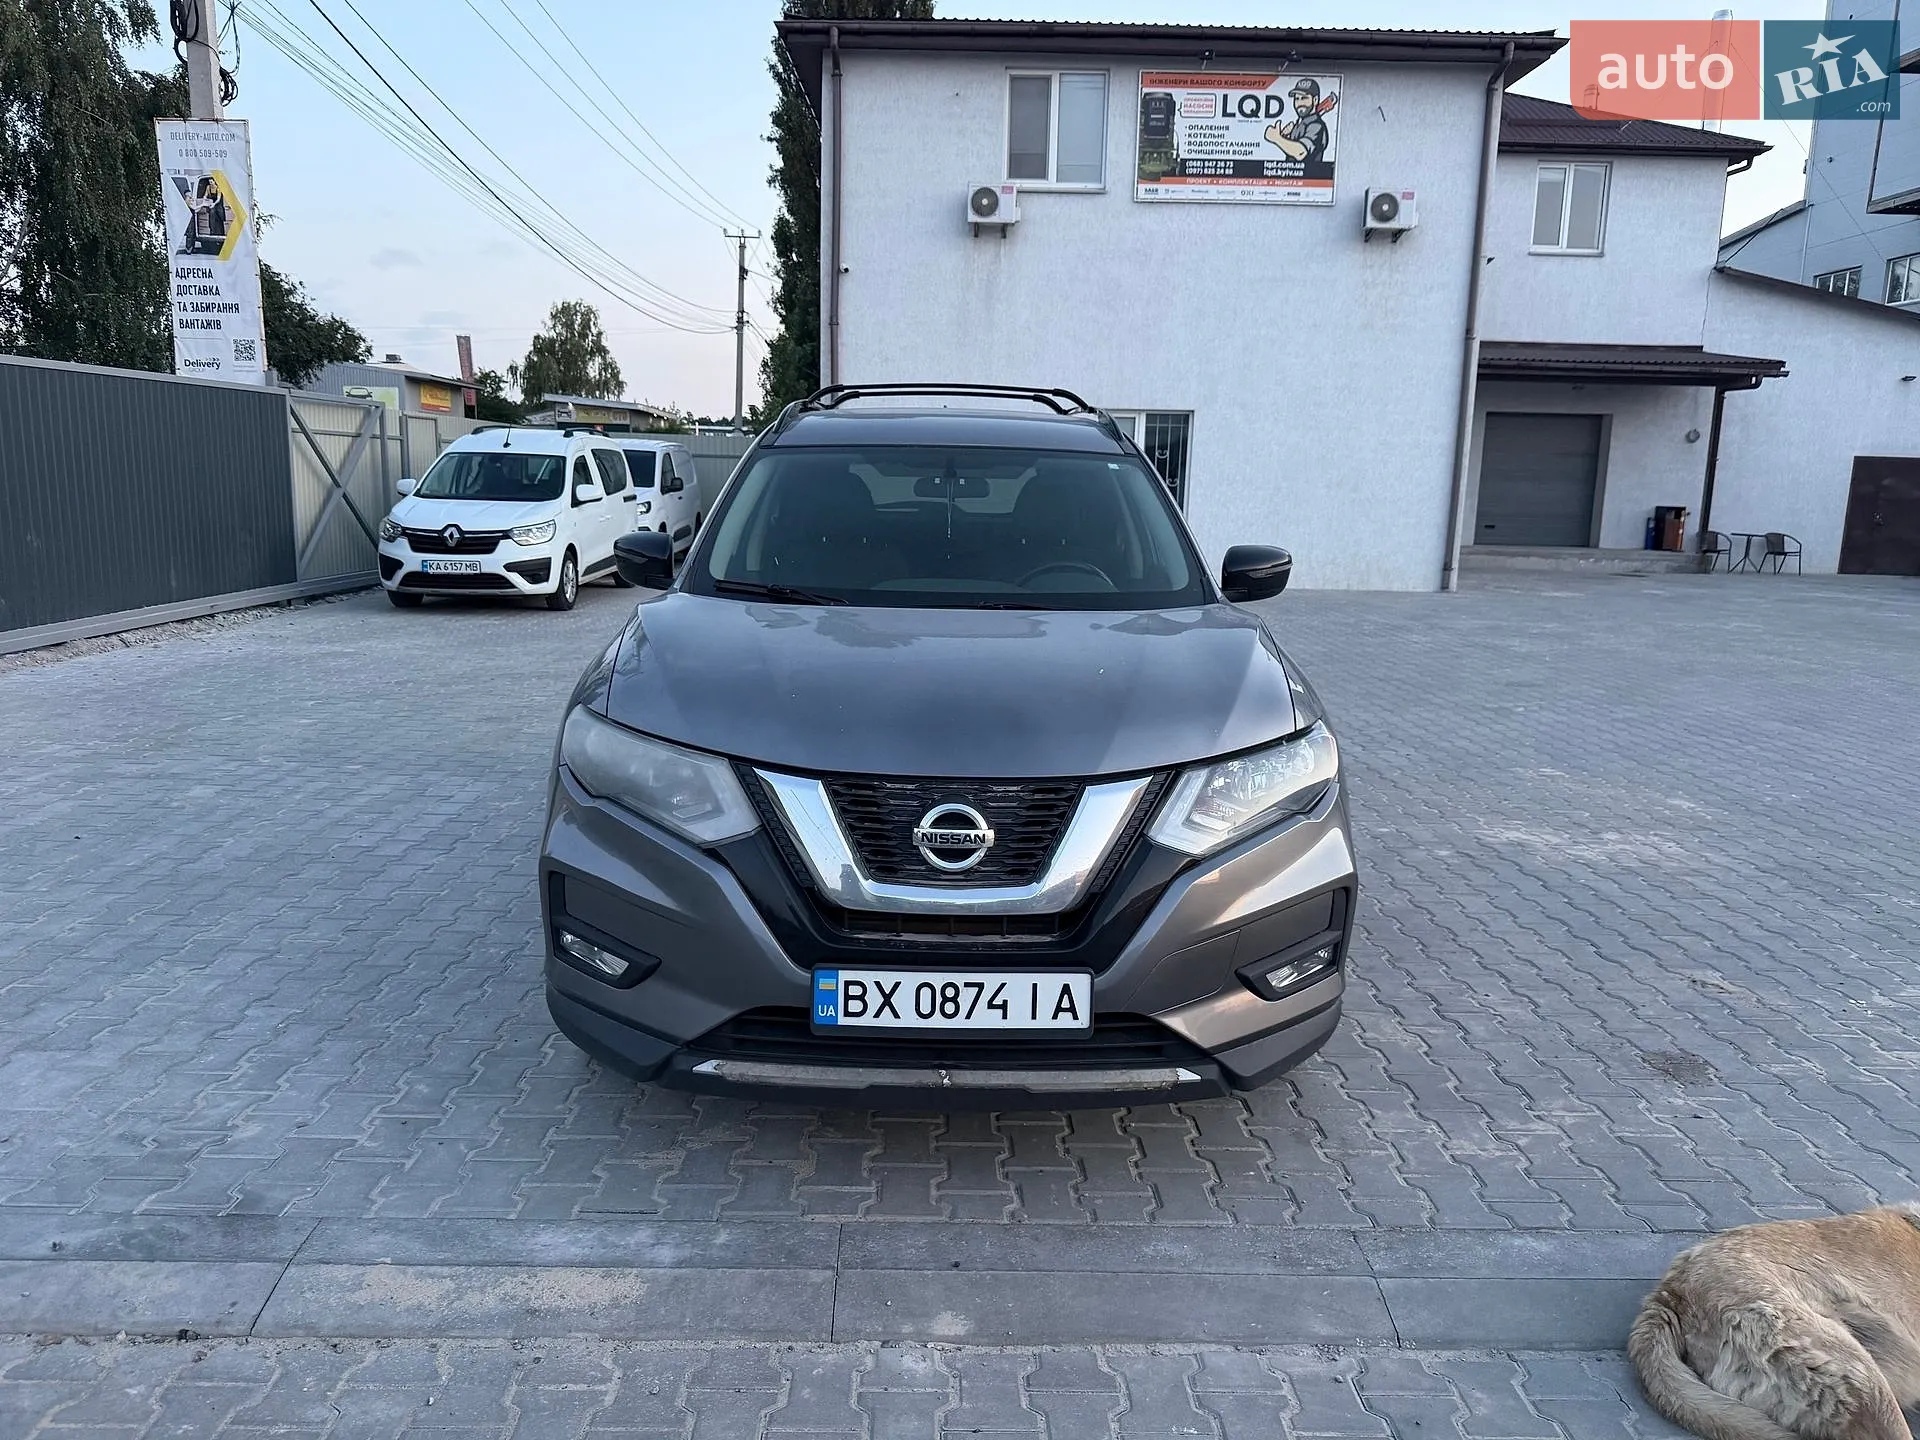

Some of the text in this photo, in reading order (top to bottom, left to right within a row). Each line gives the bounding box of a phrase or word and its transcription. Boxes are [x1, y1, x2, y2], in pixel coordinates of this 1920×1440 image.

[1225, 79, 1267, 87] КОМФОРТУ
[1221, 93, 1285, 118] LQD
[170, 131, 236, 141] DELIVERY-AUTO.COM
[178, 149, 183, 157] 0
[199, 150, 228, 158] 509-509
[1264, 161, 1305, 169] lqd.com.ua
[175, 267, 213, 280] АДРЕСНА
[176, 284, 221, 297] ДОСТАВКА
[177, 301, 240, 314] ТА ЗАБИРАННЯ
[179, 318, 222, 330] ВАНТАЖІВ
[184, 358, 221, 370] Delivery
[428, 562, 479, 572] KA 6157 MB
[921, 832, 986, 845] NISSAN
[843, 979, 902, 1019] BX
[914, 981, 1008, 1020] 0874
[818, 1004, 836, 1017] UA
